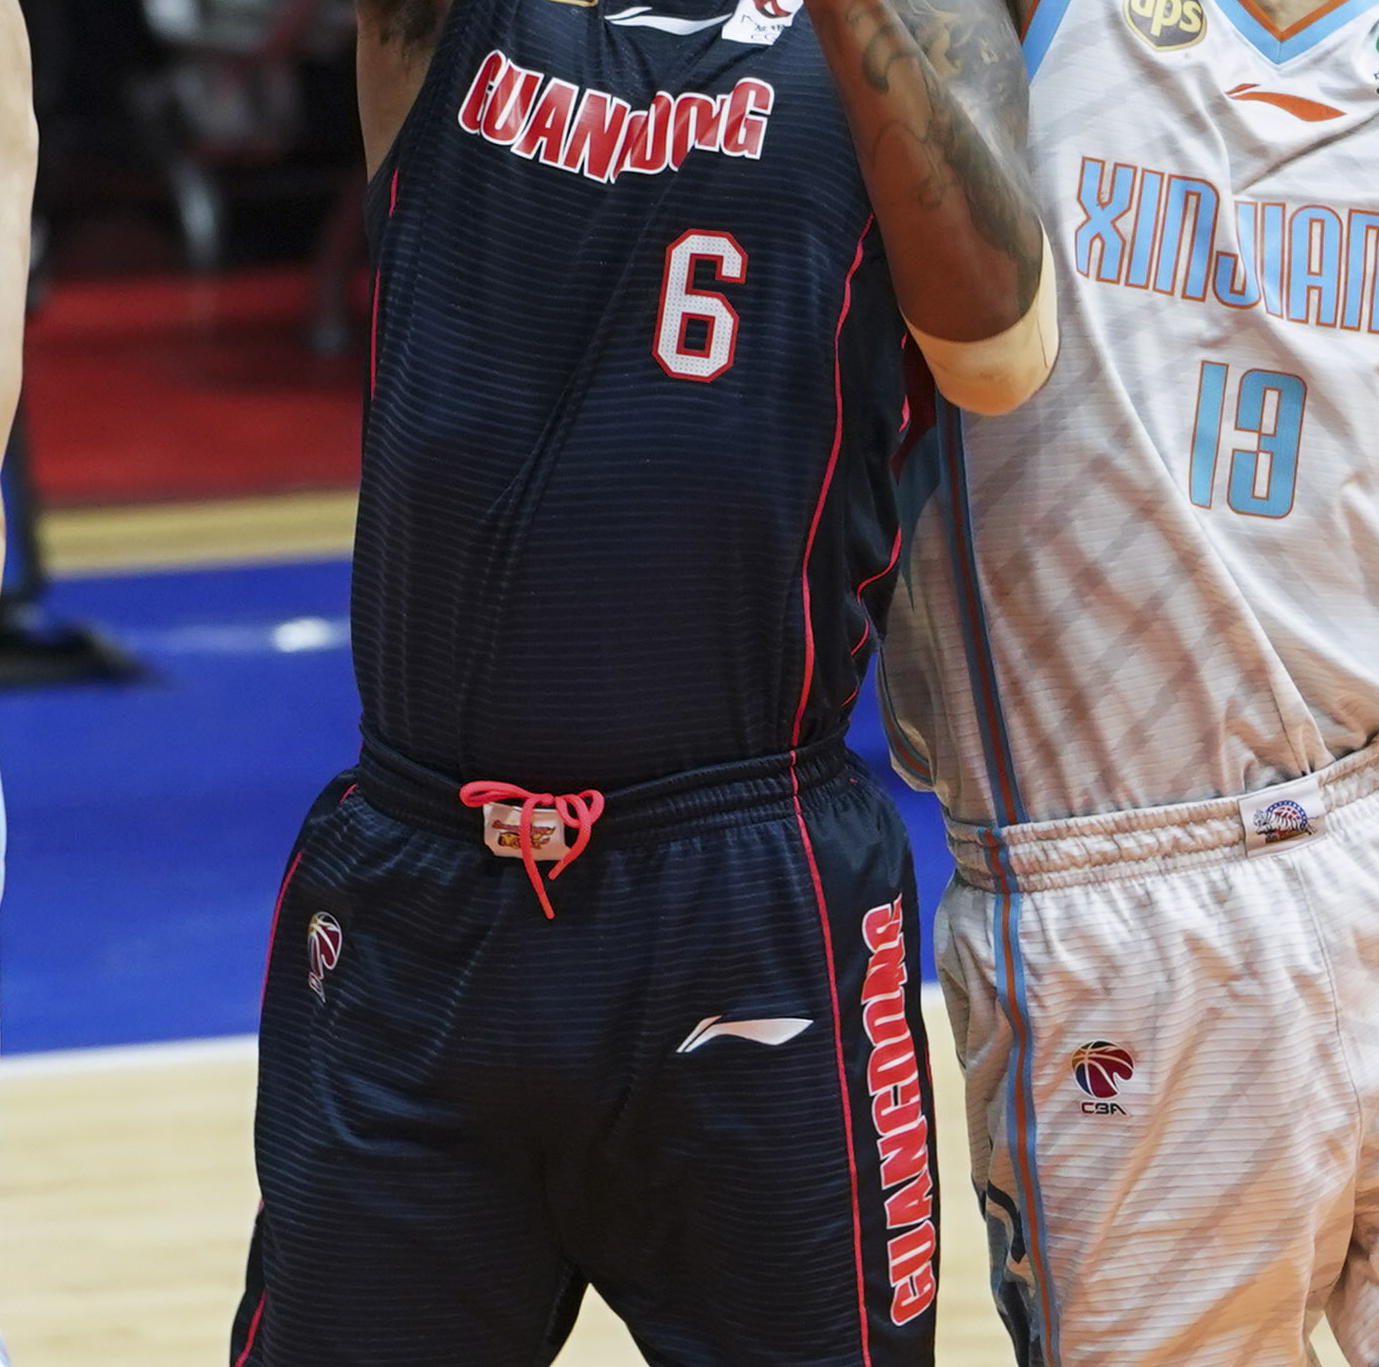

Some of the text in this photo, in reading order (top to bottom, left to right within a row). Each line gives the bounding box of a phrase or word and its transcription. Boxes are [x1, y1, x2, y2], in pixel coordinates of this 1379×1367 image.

[651, 228, 748, 383] 6
[1188, 360, 1308, 519] 13
[1081, 1101, 1128, 1116] CBA
